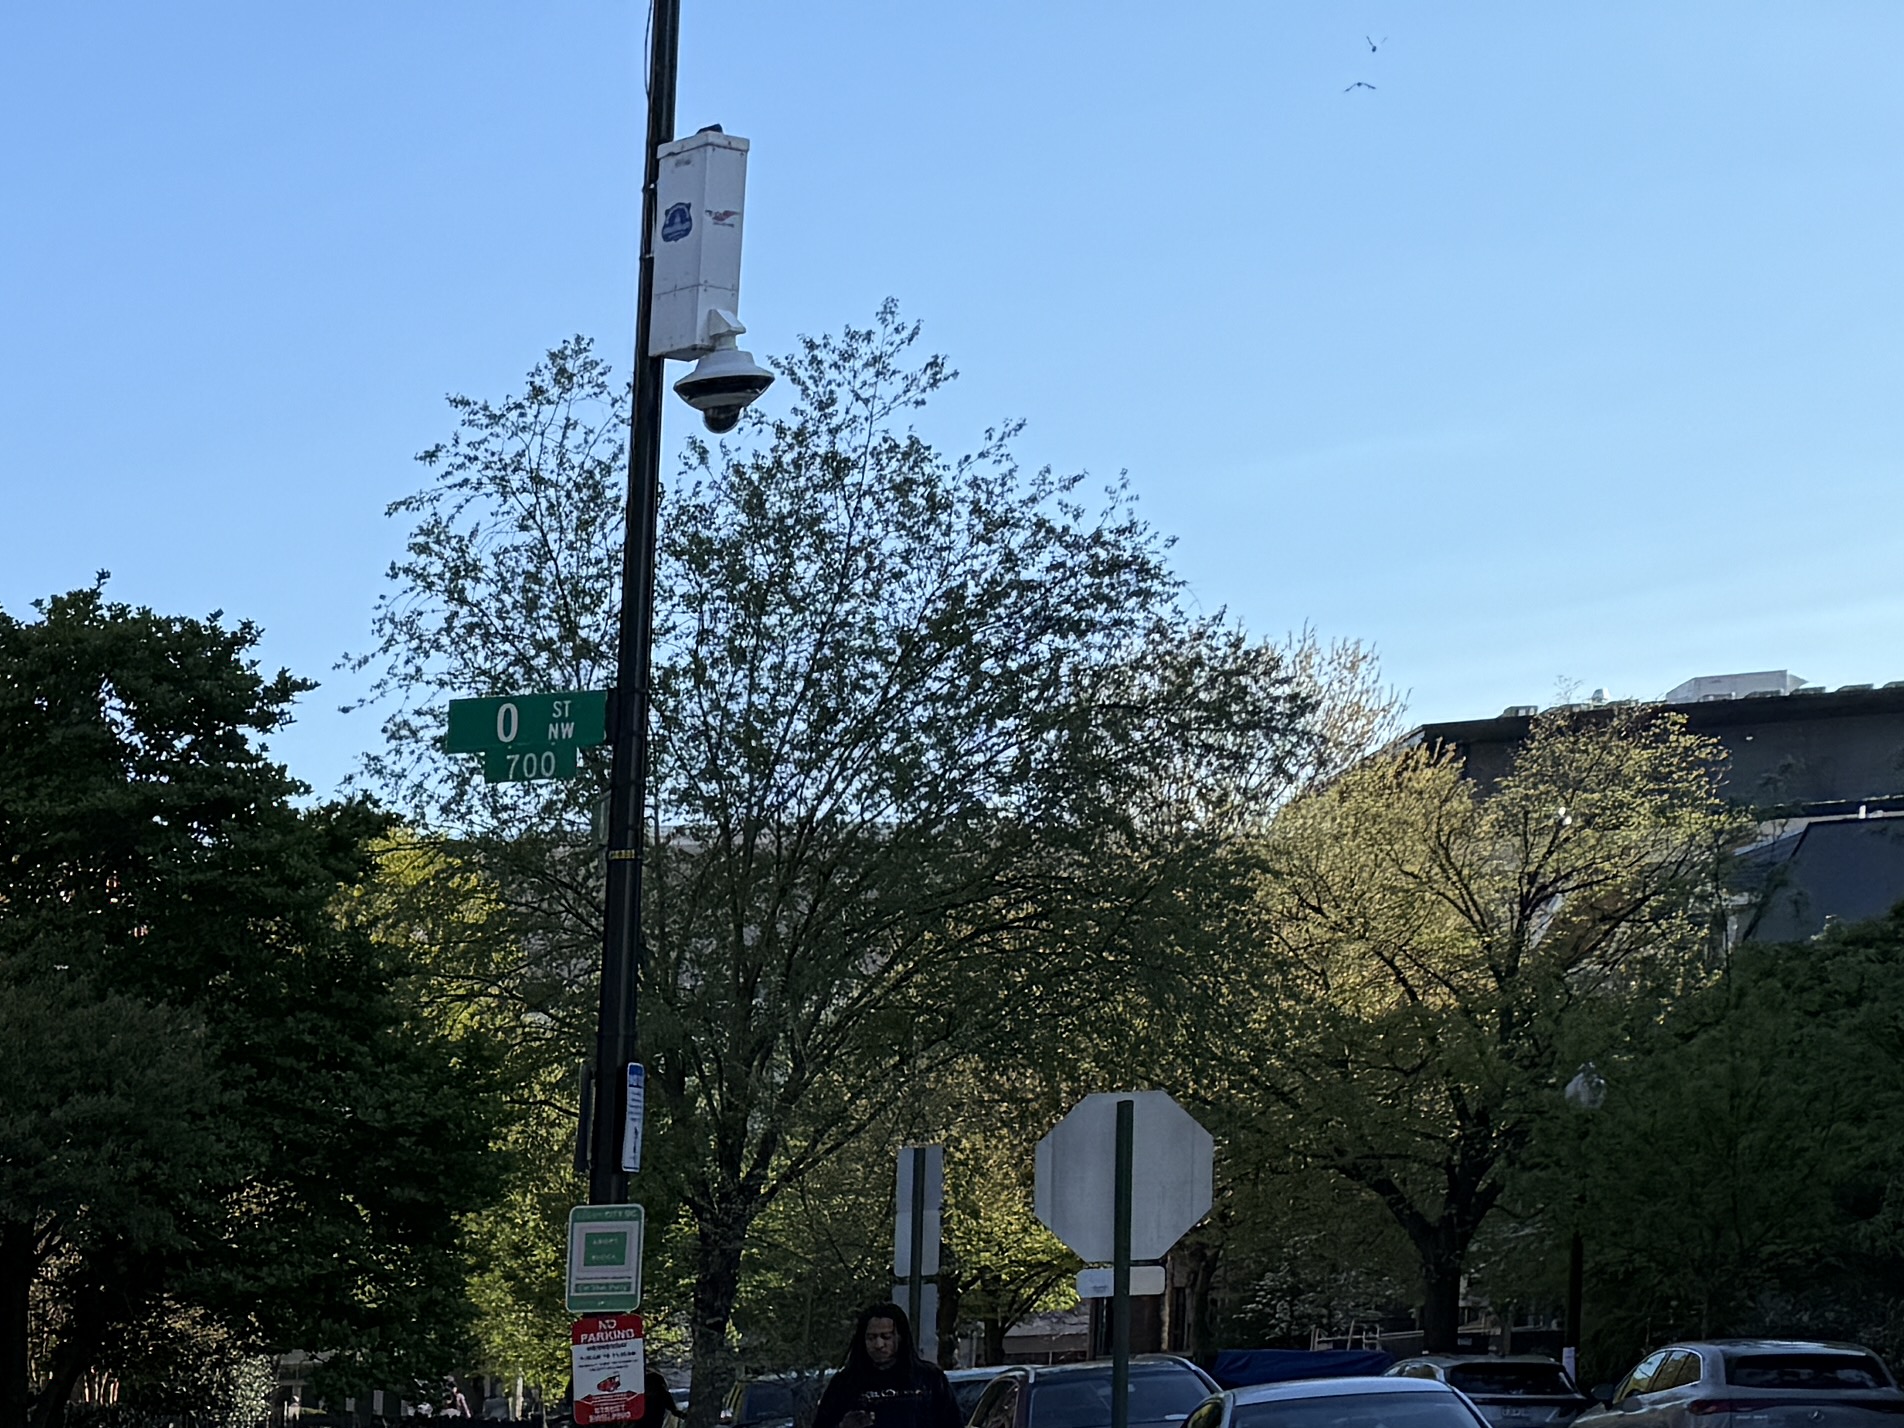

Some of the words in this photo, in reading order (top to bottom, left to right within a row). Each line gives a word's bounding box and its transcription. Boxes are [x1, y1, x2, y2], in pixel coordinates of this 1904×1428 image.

[552, 700, 572, 718] ST
[548, 722, 574, 740] NW
[506, 751, 556, 780] 700
[598, 1319, 617, 1330] NO
[581, 1328, 635, 1343] PARKING
